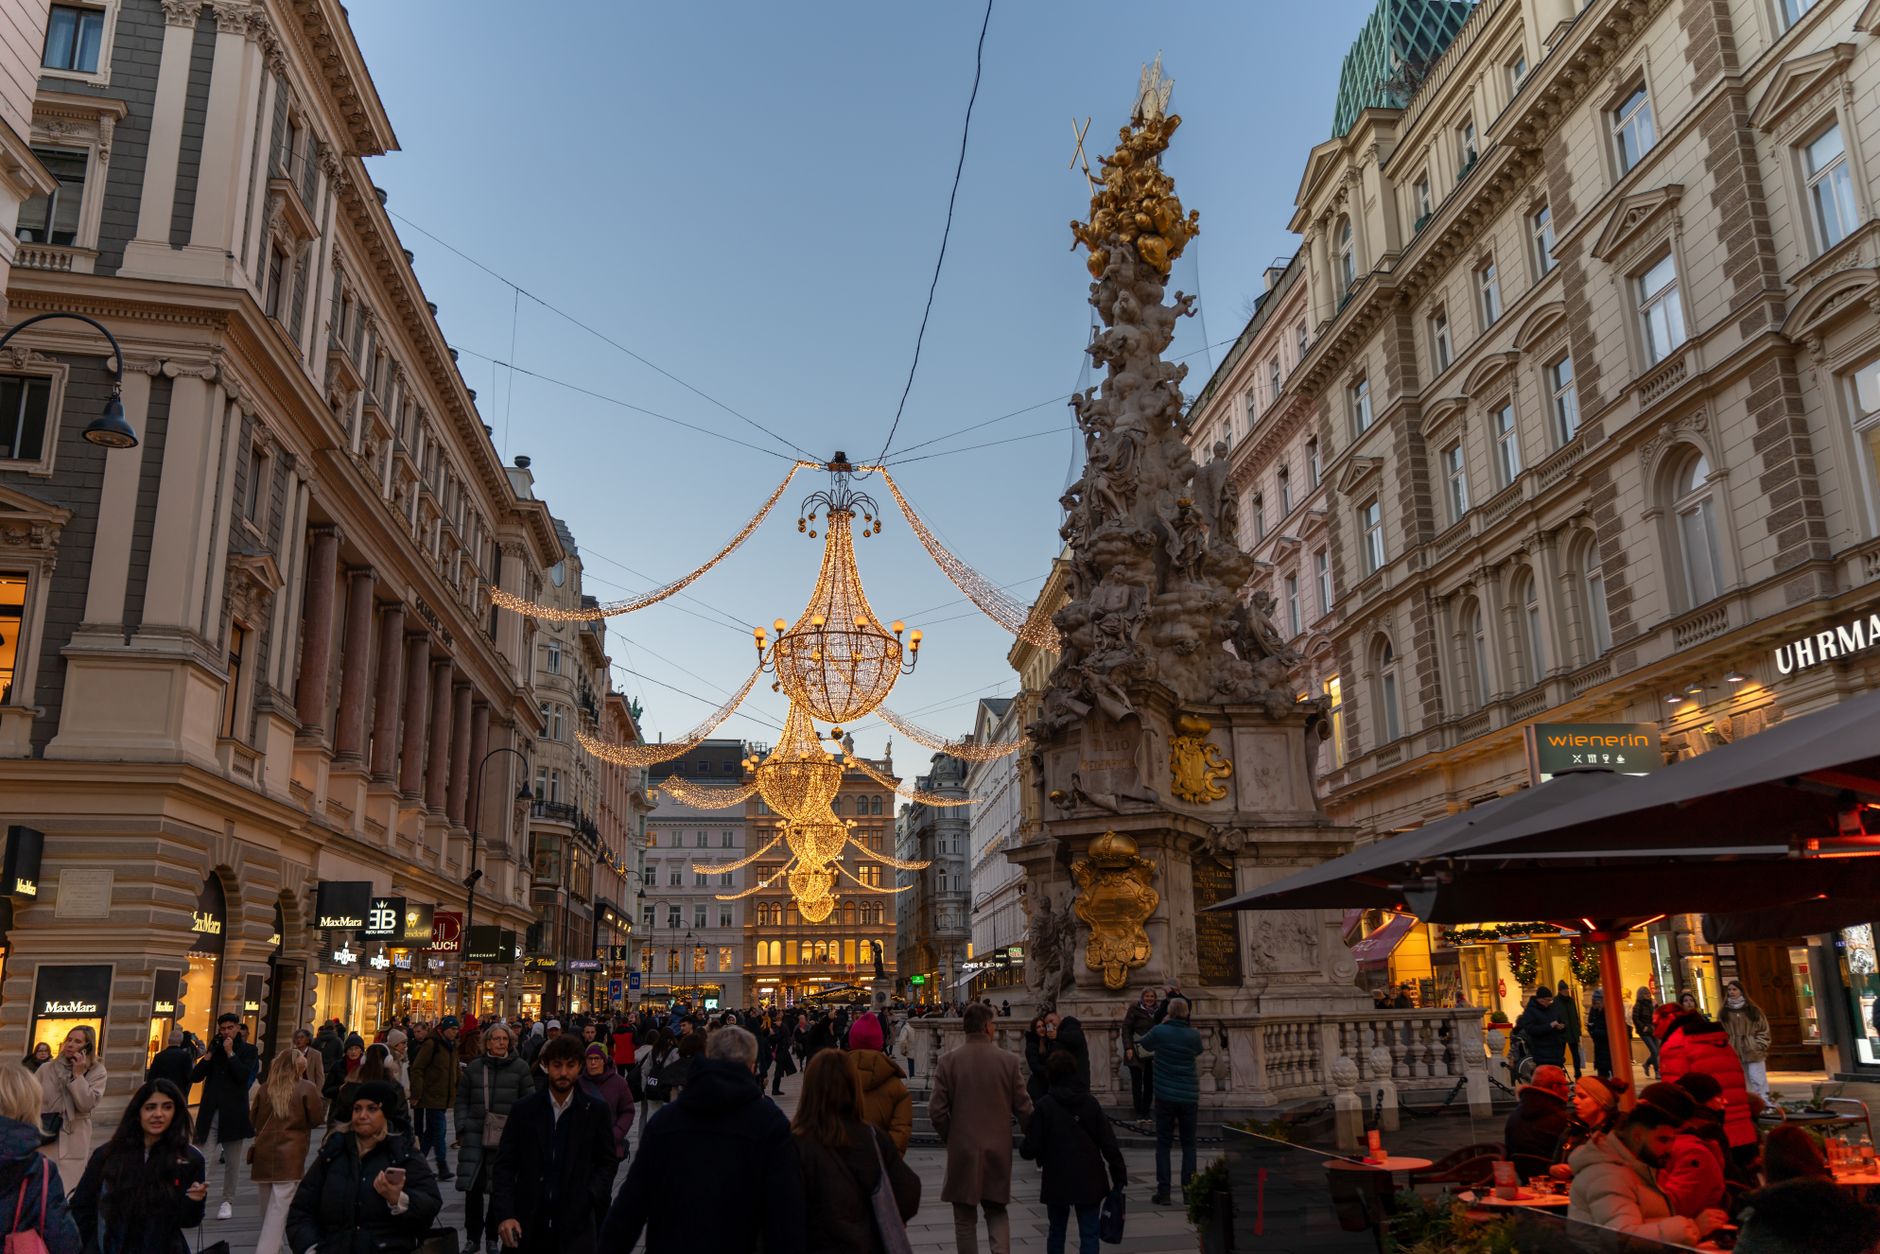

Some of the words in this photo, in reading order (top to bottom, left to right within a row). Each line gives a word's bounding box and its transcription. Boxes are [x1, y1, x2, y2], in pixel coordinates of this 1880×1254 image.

[1547, 733, 1649, 747] wienerin
[191, 911, 221, 934] axMara
[320, 916, 362, 927] MaxMara
[404, 928, 432, 938] endorff
[426, 941, 459, 951] AUCH
[44, 1001, 97, 1013] MaxMara
